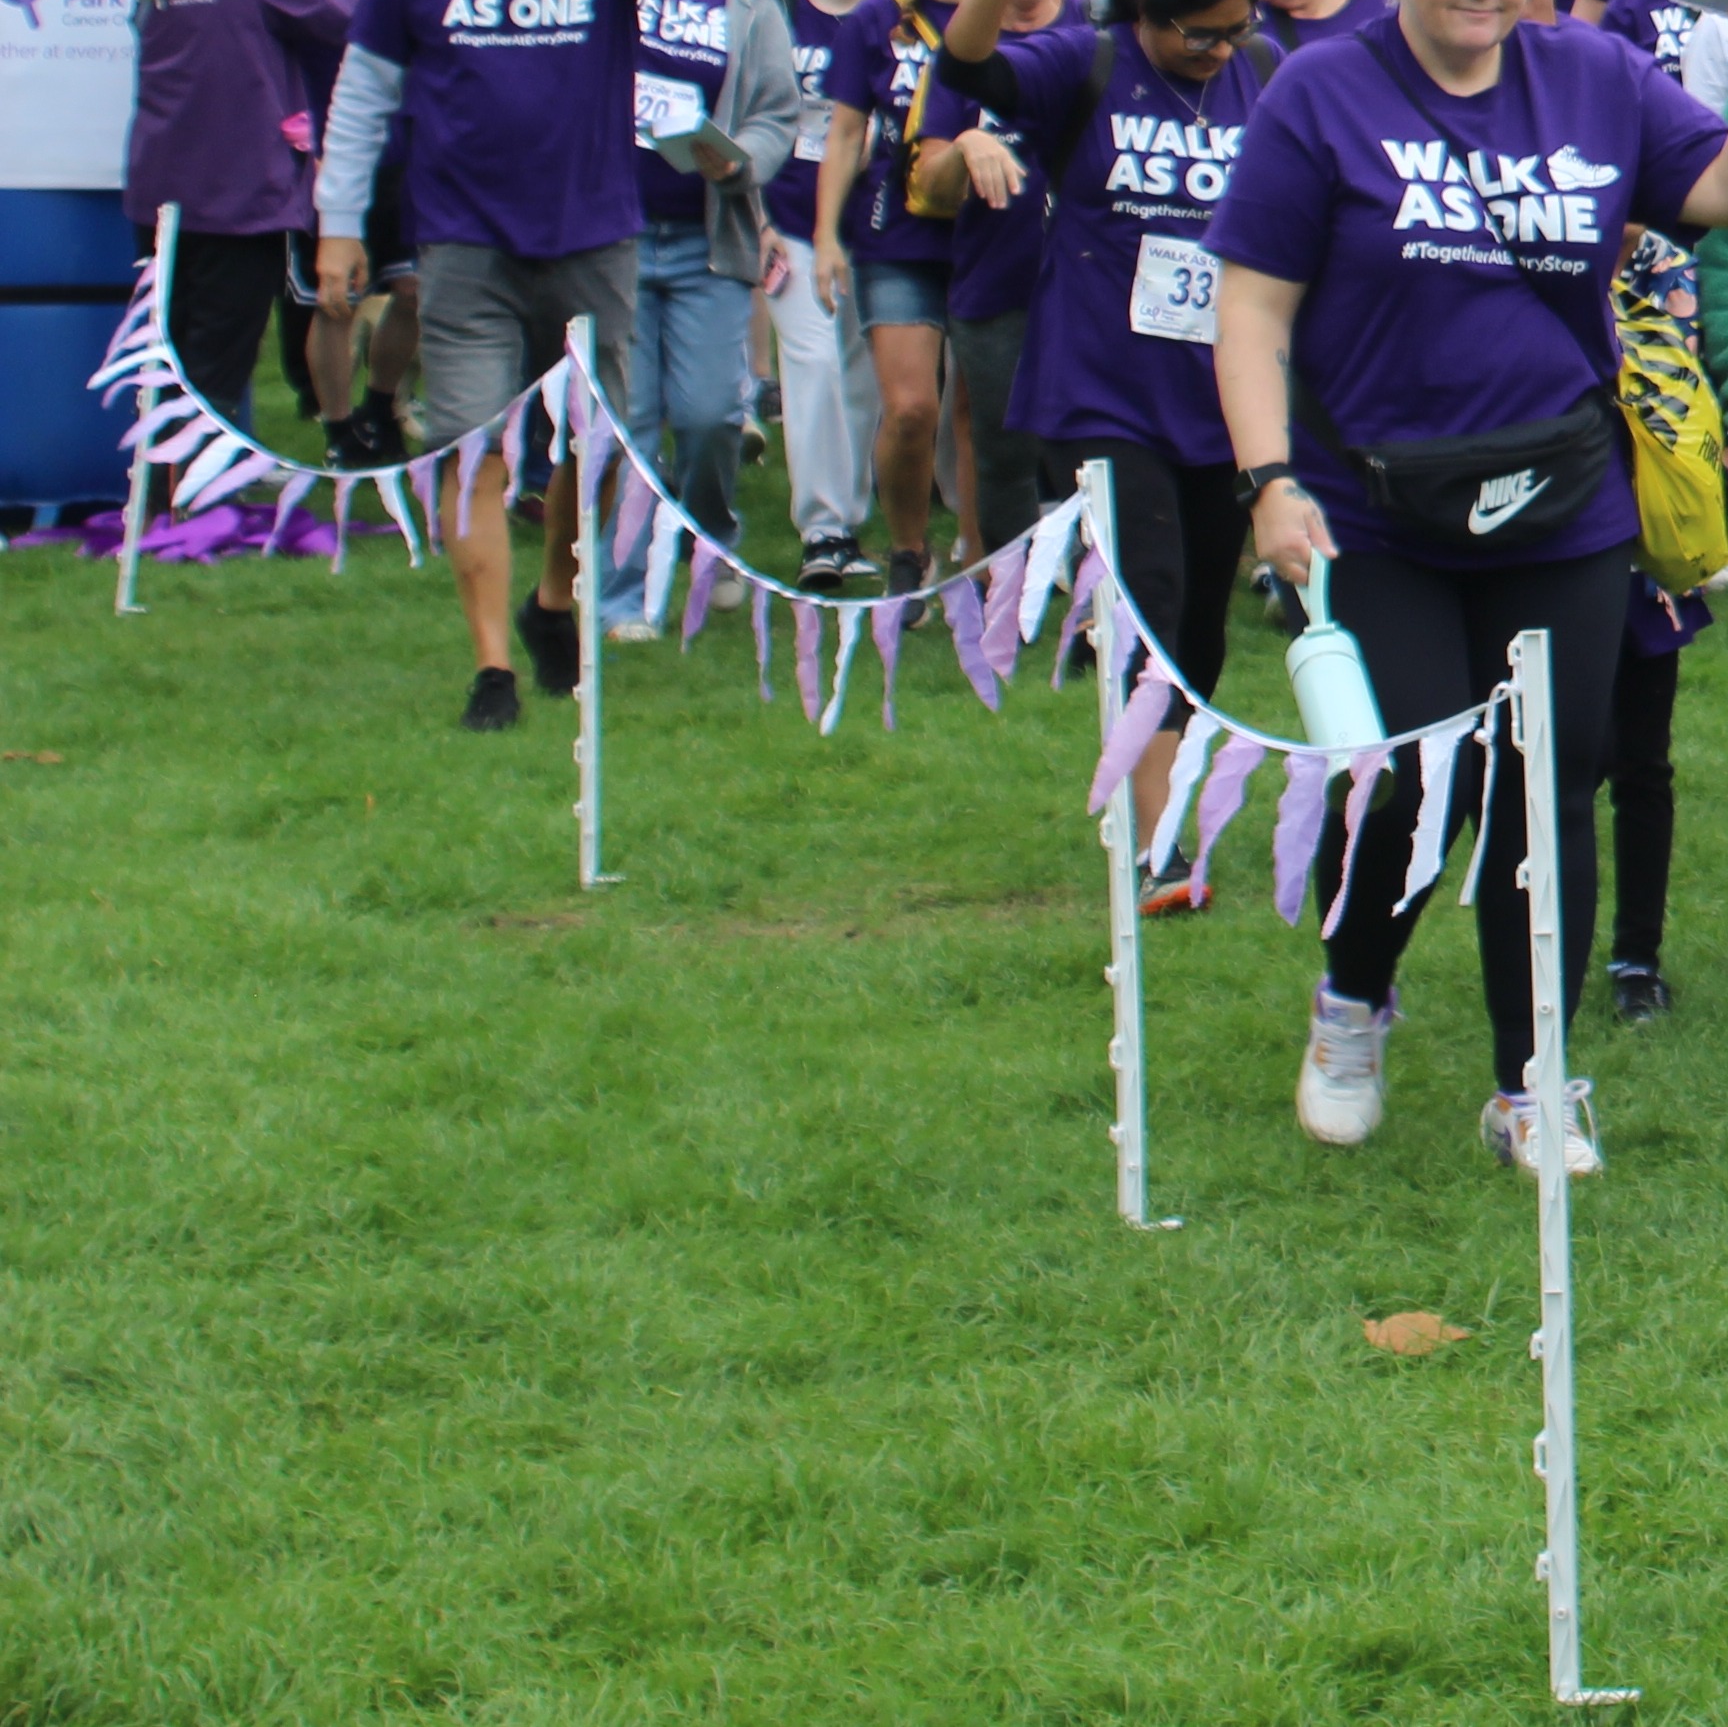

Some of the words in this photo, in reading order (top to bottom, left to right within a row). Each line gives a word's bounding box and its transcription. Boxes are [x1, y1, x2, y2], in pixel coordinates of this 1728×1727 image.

[43, 45, 59, 59] at
[659, 16, 727, 54] ONE
[1110, 114, 1243, 161] WALK
[1105, 153, 1175, 196] AS
[1393, 183, 1478, 232] AS
[1484, 194, 1600, 244] ONE
[1149, 246, 1188, 264] WALK
[1190, 253, 1207, 267] AS
[1167, 267, 1215, 310] 33
[1478, 468, 1533, 511] NIKE
